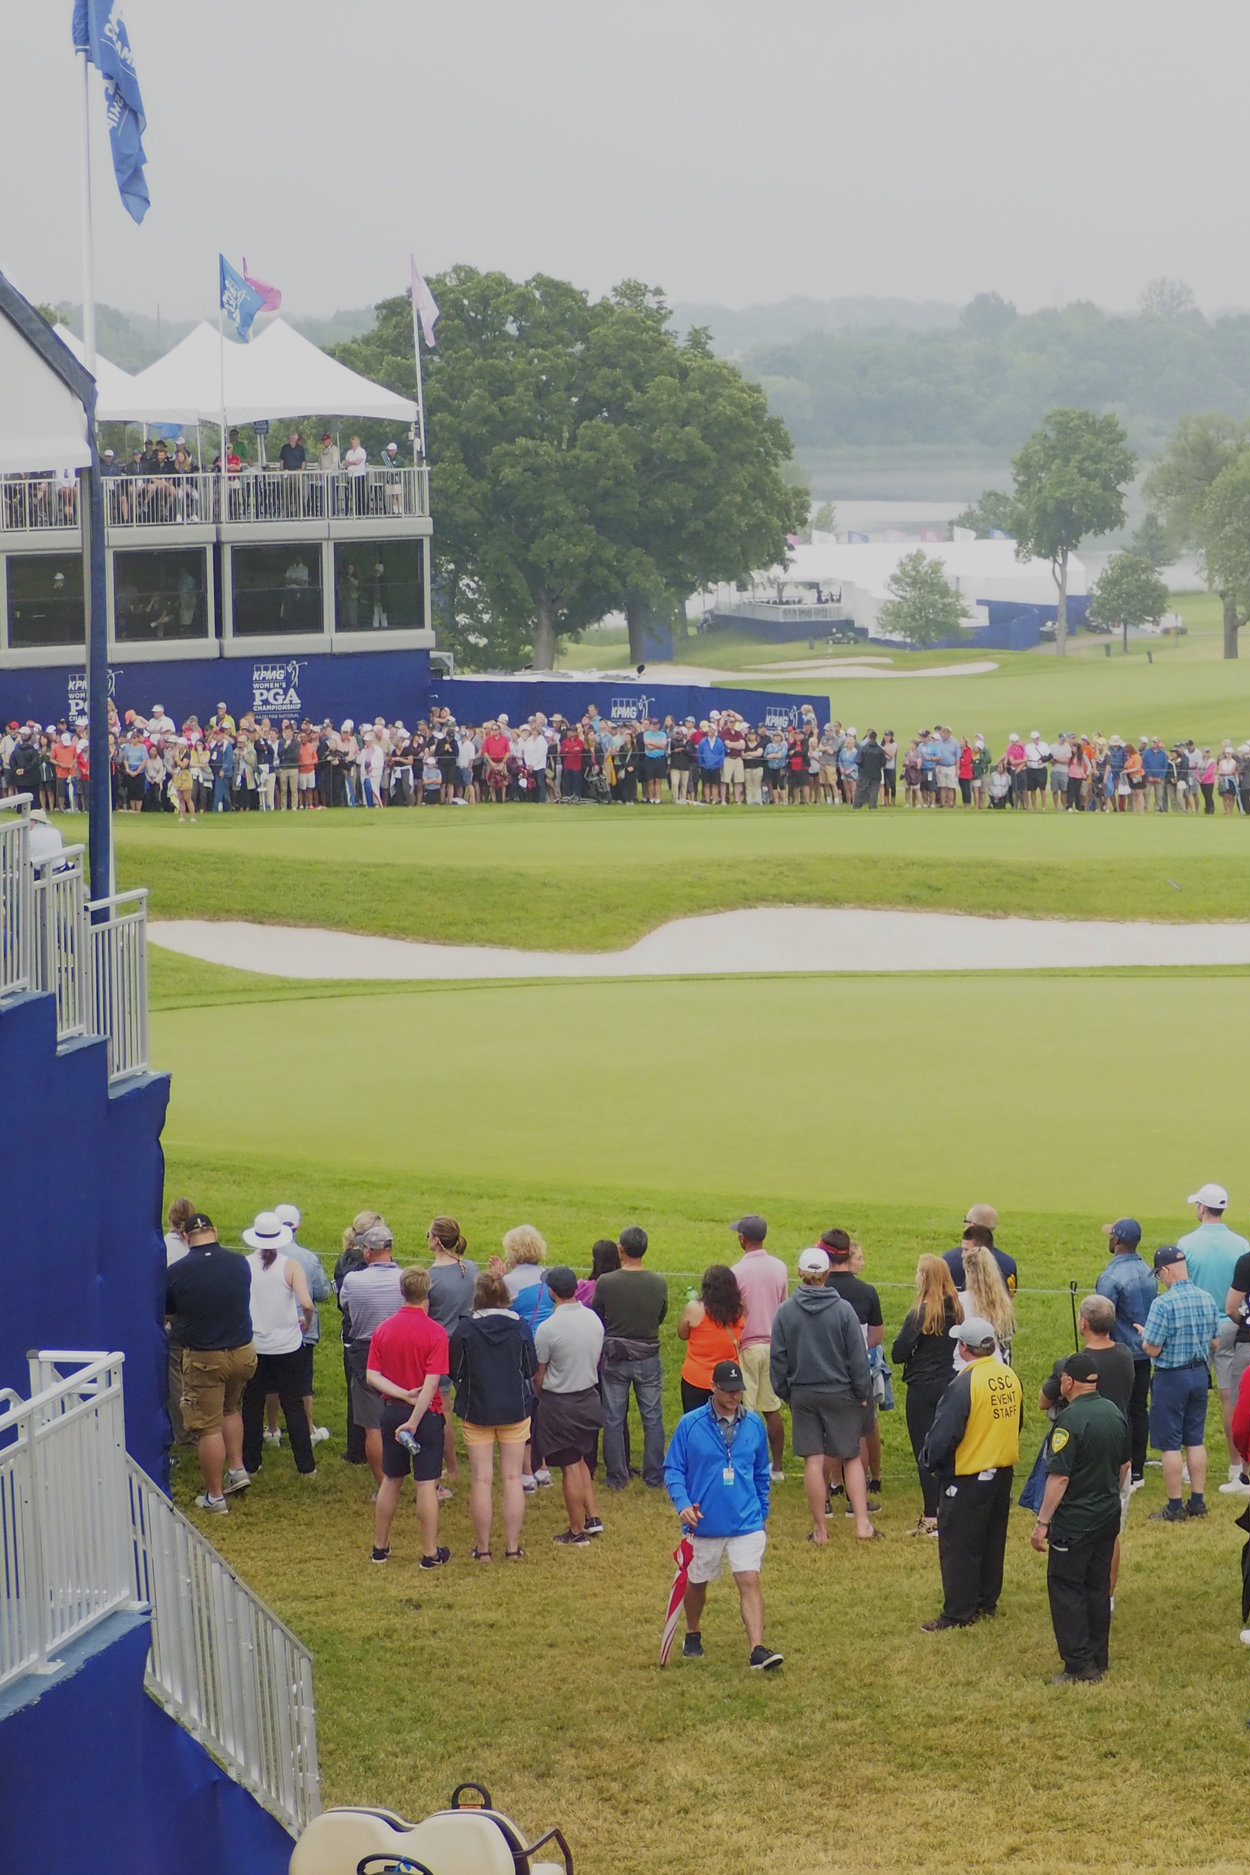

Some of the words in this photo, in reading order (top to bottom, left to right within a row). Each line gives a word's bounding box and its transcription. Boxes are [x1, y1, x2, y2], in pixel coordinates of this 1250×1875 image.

[253, 670, 285, 680] KPMG
[253, 688, 301, 705] PGA
[611, 706, 637, 718] KPMG
[988, 1375, 1012, 1391] CSC
[991, 1391, 1015, 1406] EVENT
[993, 1405, 1016, 1419] STAFF
